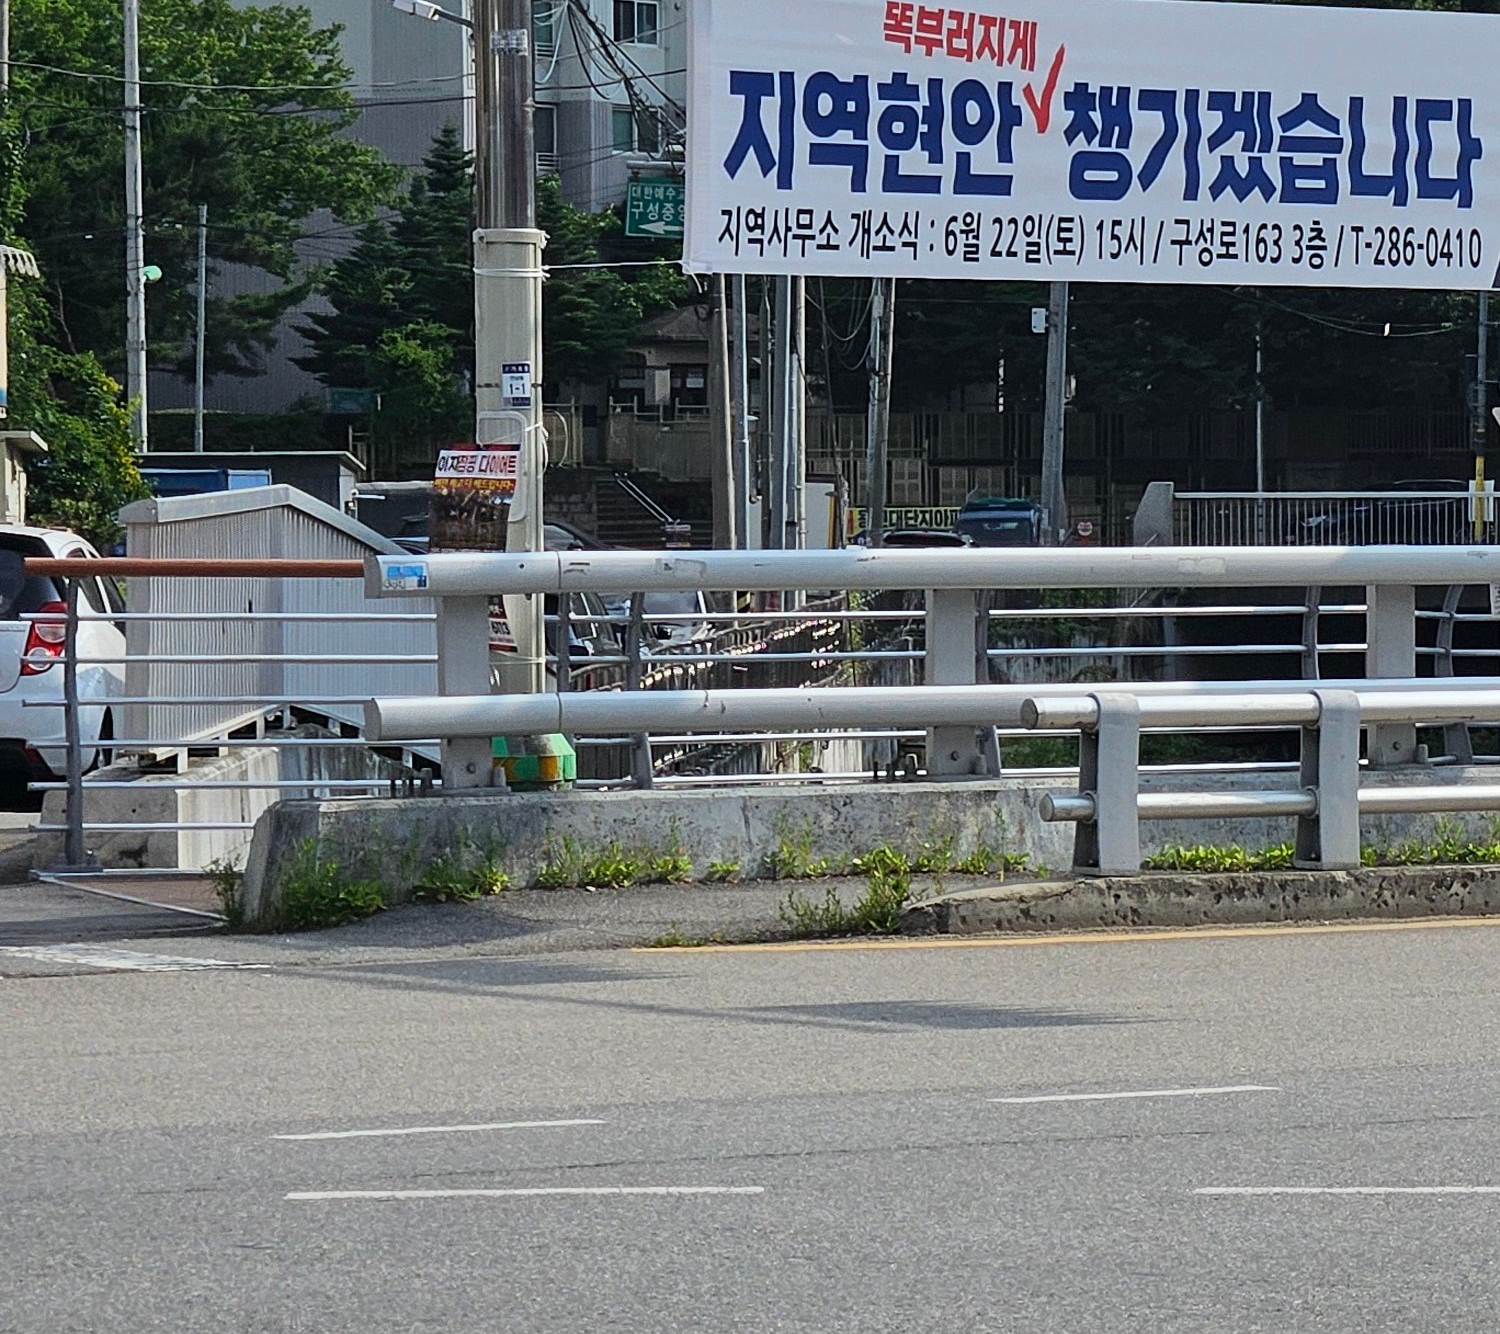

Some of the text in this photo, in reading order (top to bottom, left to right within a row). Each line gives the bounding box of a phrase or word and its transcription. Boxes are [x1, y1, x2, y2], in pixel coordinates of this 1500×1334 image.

[883, 0, 1038, 71] 똑부러지게
[724, 69, 1483, 208] 지역현안 챙기겠습니다
[718, 207, 840, 259] 지역사무소
[849, 209, 919, 261] 개소식
[944, 213, 981, 262] 6월
[990, 214, 1085, 264] 22일(토)
[1096, 216, 1145, 266] 15시
[1170, 219, 1282, 267] 구성로163
[1291, 221, 1328, 269] 3층
[1351, 226, 1482, 268] T-286-0410
